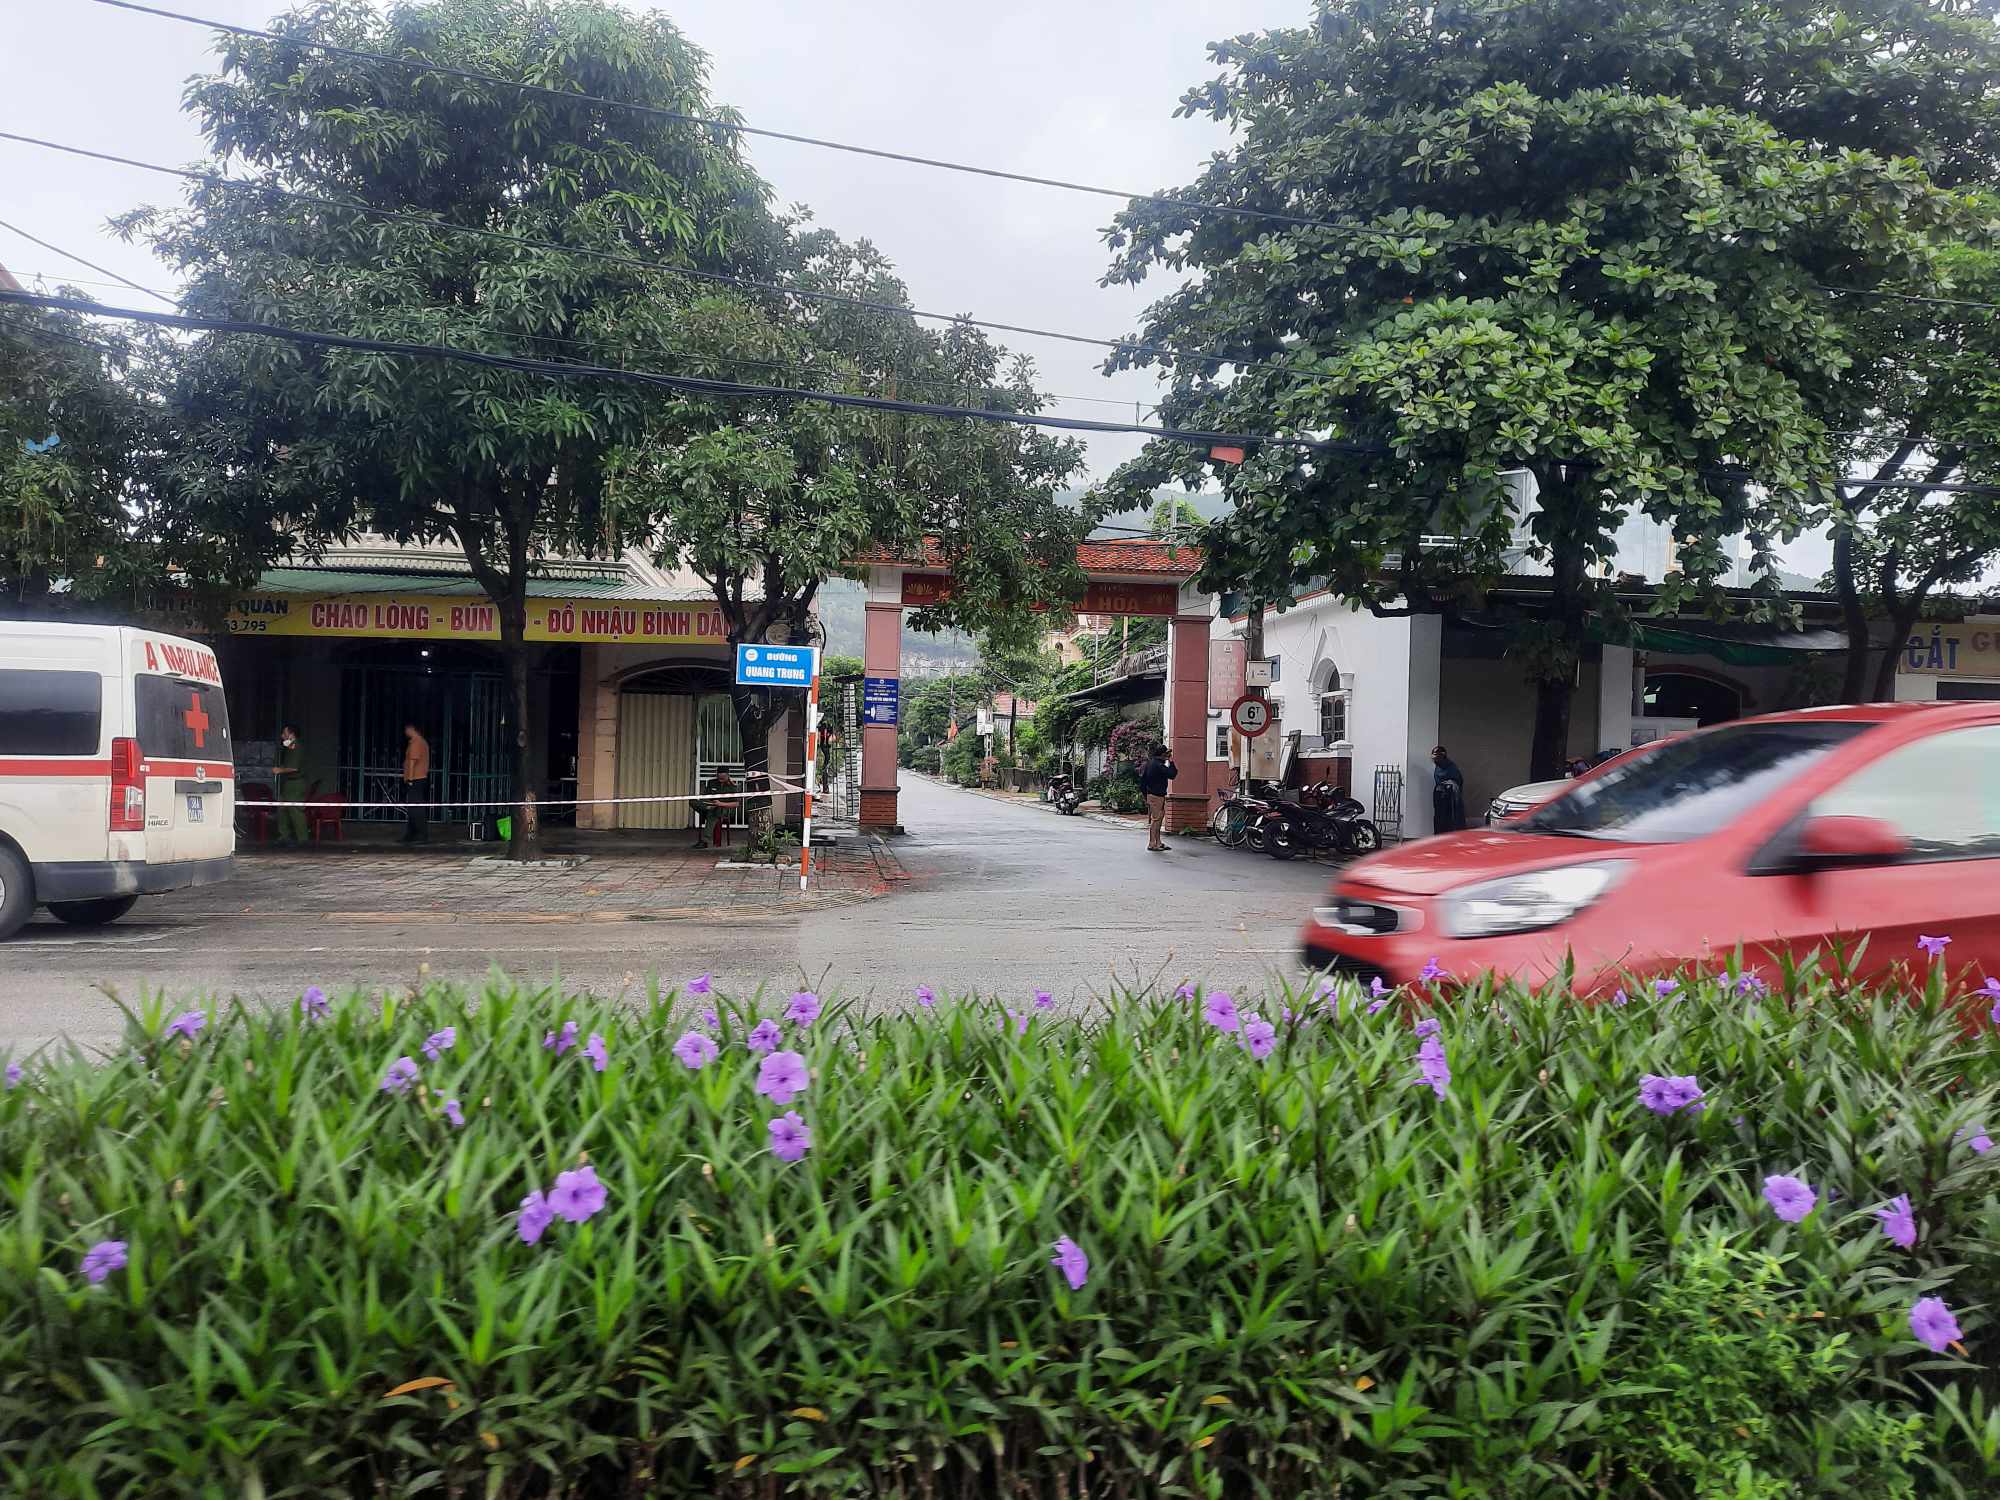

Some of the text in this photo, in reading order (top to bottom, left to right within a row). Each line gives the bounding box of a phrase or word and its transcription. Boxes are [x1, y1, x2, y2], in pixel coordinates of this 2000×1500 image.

[311, 600, 368, 629] CHÁO
[374, 600, 429, 630] LÒNG
[450, 602, 493, 631] BÚN
[581, 606, 636, 639] NHẬU
[643, 607, 690, 635] BÌNH
[1908, 625, 1961, 669] CẮT
[745, 665, 805, 680] QUANG TRUNG
